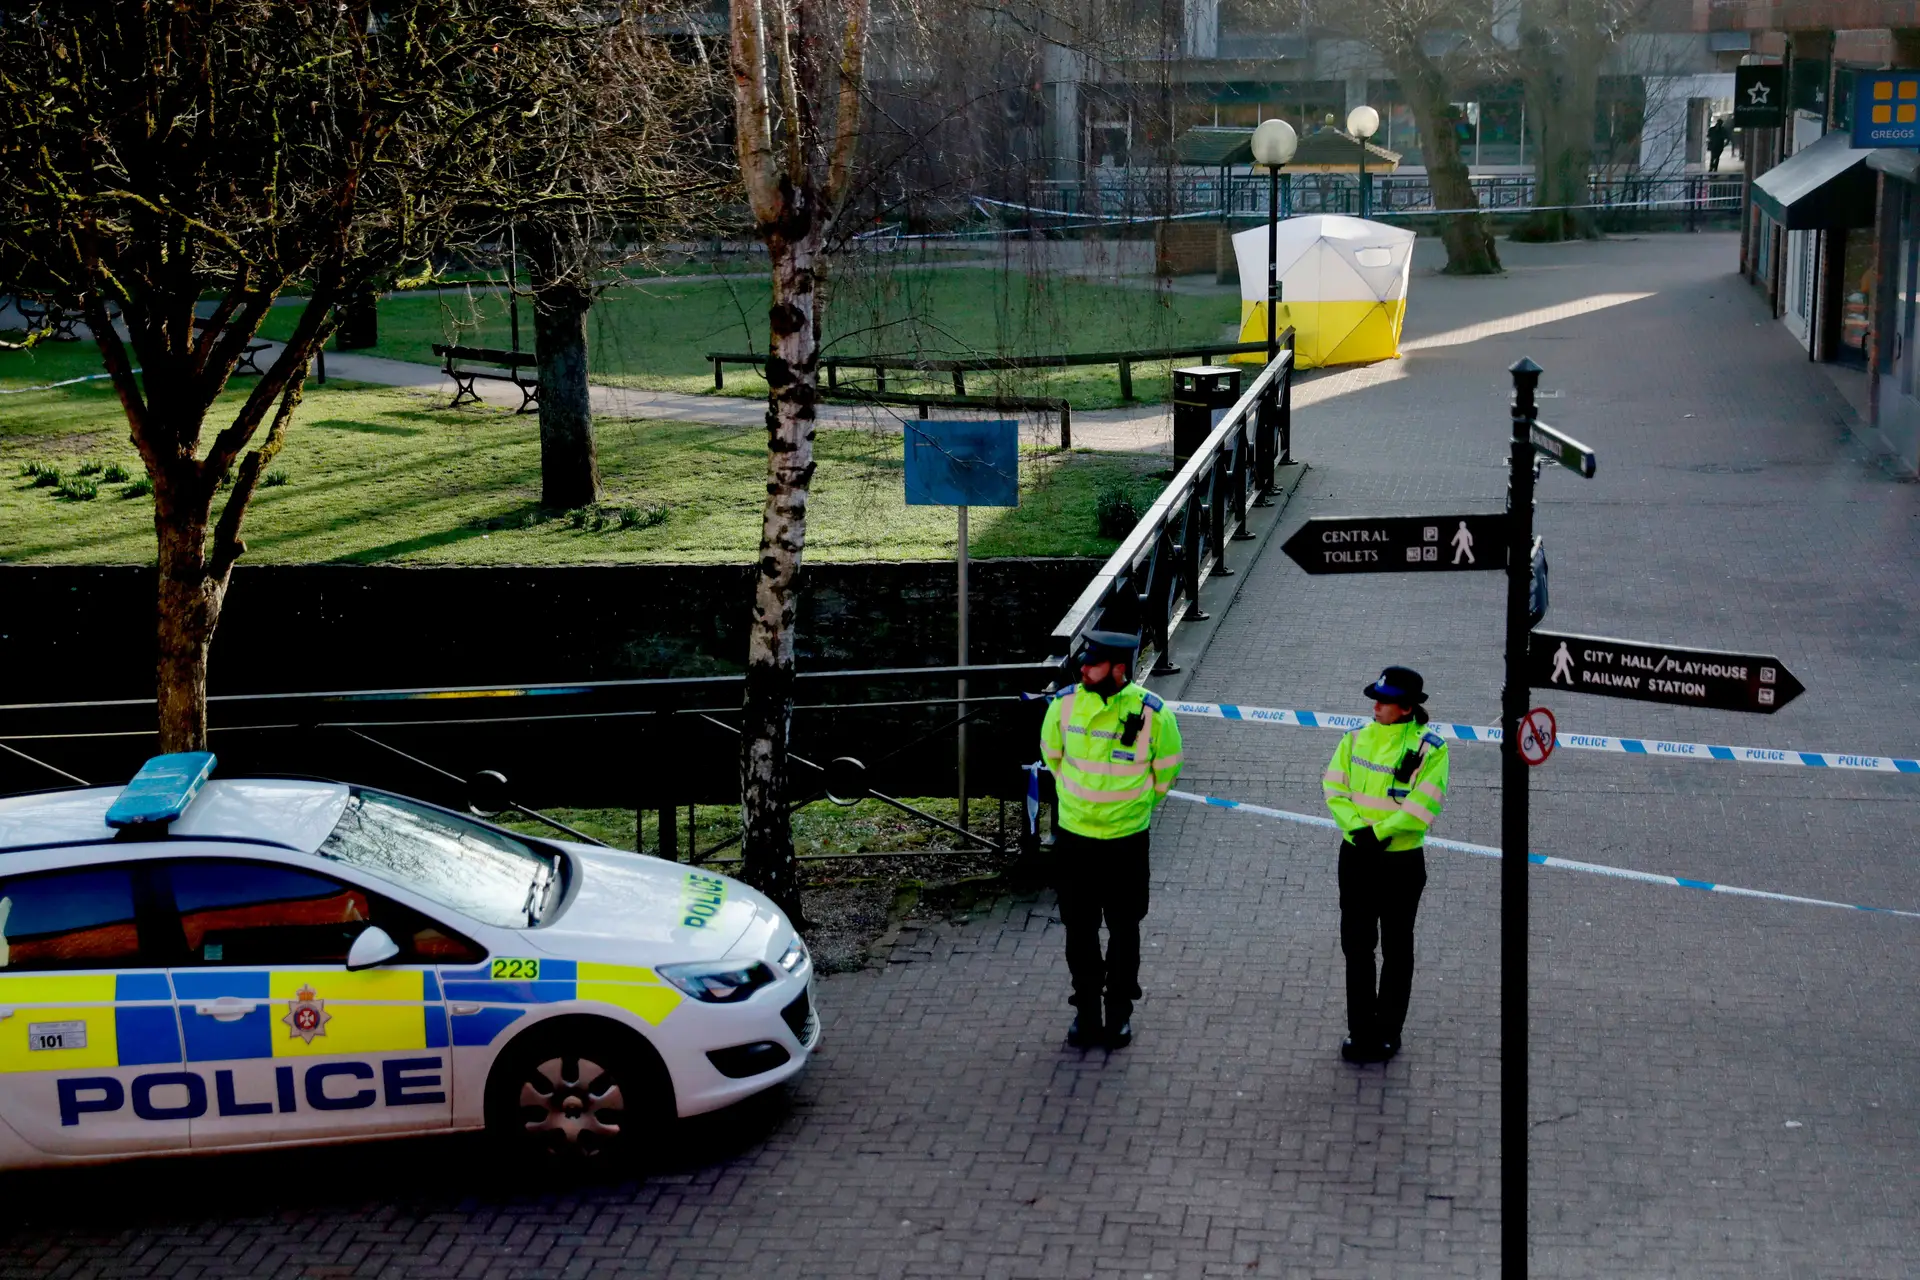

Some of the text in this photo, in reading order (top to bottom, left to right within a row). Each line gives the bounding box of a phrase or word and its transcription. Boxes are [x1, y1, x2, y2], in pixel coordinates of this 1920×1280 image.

[1871, 129, 1915, 140] GREGGS
[1322, 530, 1390, 544] CENTRAL
[1323, 550, 1379, 564] TOILETS
[1583, 649, 1748, 680] CITY HALL/PLAYHOUSE
[1582, 670, 1706, 697] RAILWAY STATION
[1251, 709, 1285, 720] POLICE
[1327, 715, 1362, 727] POLICE
[1570, 735, 1607, 747] POLICE
[1656, 742, 1695, 754] POLICE
[1745, 749, 1785, 761] POLICE
[1837, 755, 1880, 768] POLICE
[683, 874, 723, 929] POLICE
[493, 959, 538, 979] 223
[40, 1034, 63, 1048] 101
[56, 1055, 446, 1127] POLICE
